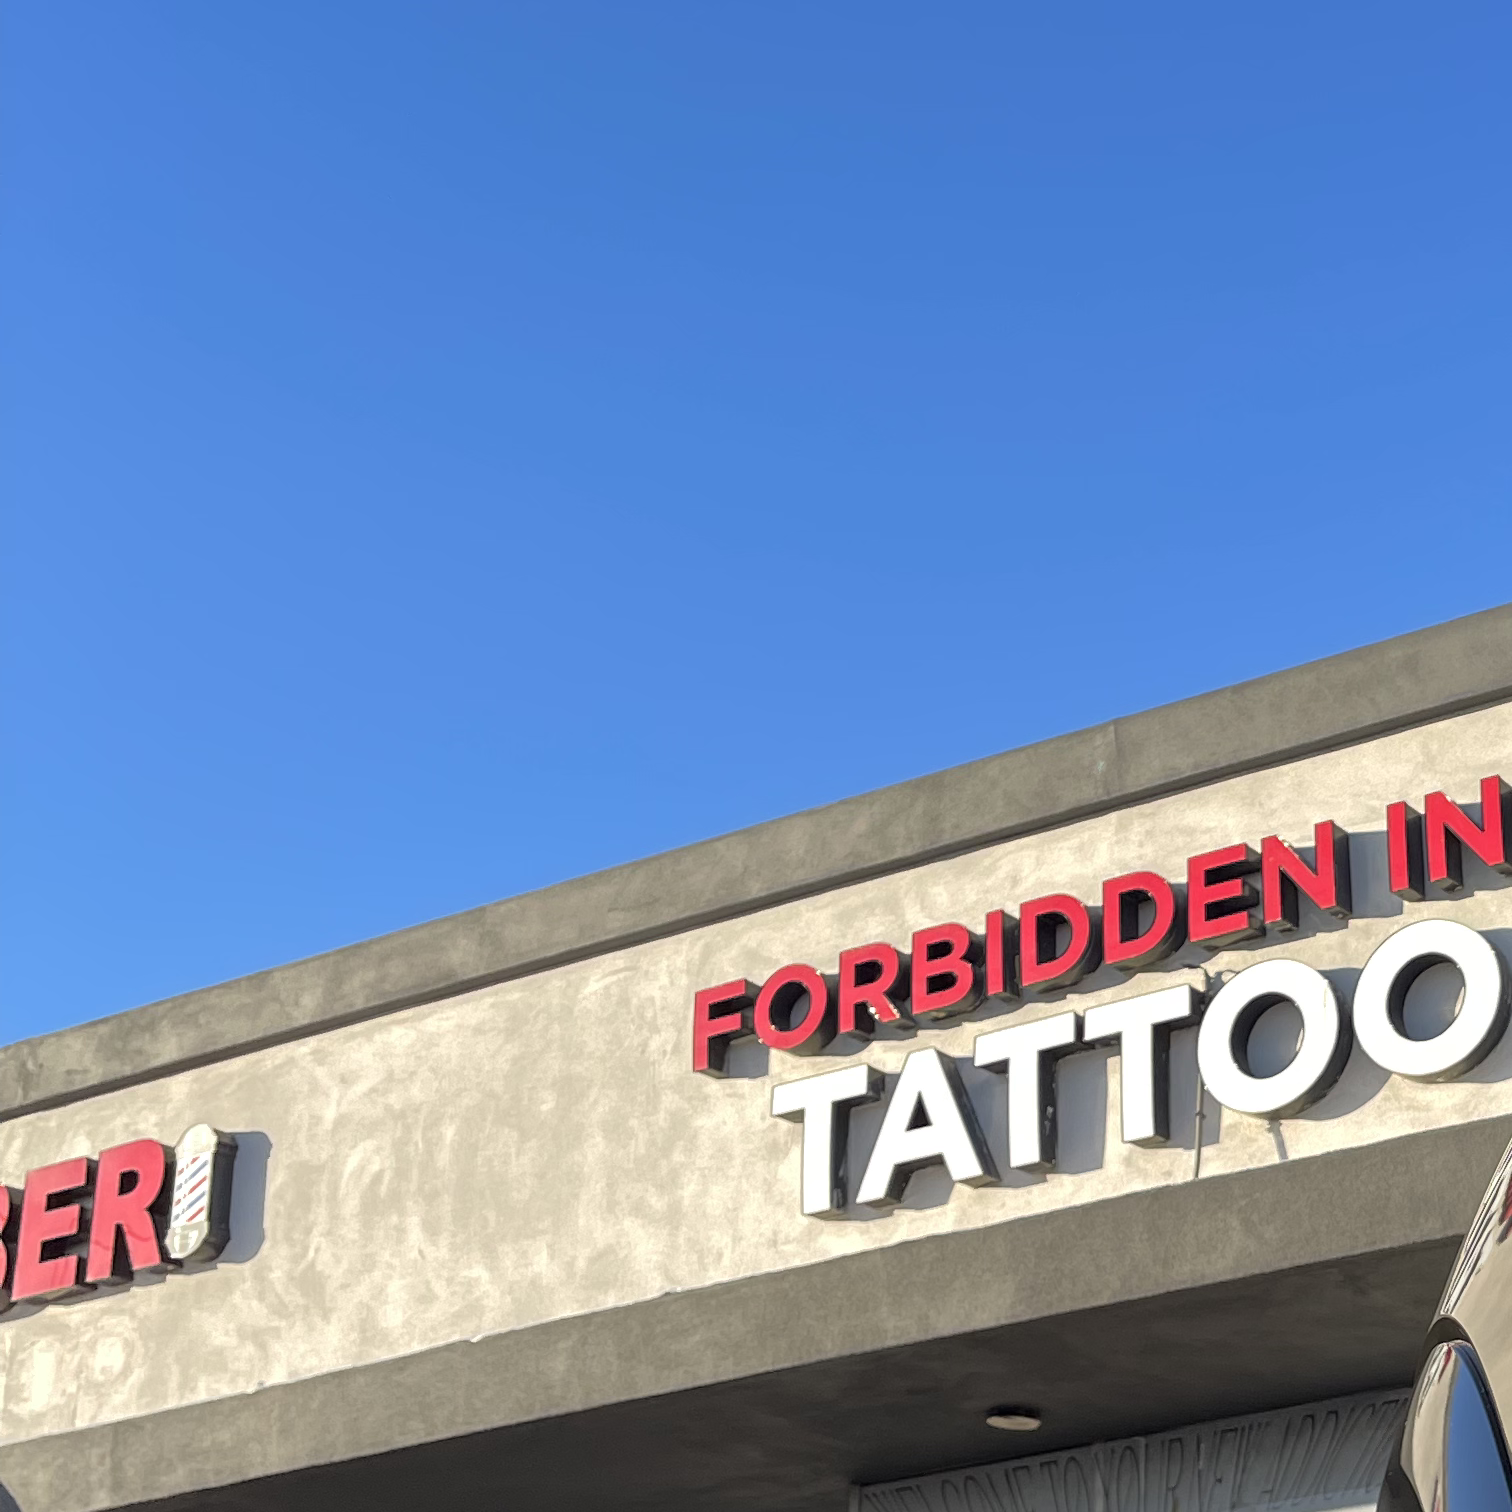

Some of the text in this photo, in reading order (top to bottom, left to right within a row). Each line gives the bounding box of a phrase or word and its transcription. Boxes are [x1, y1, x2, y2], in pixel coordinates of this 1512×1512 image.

[692, 819, 1342, 1074] FORBIDDEN
[770, 917, 1506, 1217] TATTOO
[0, 1138, 168, 1302] ER
